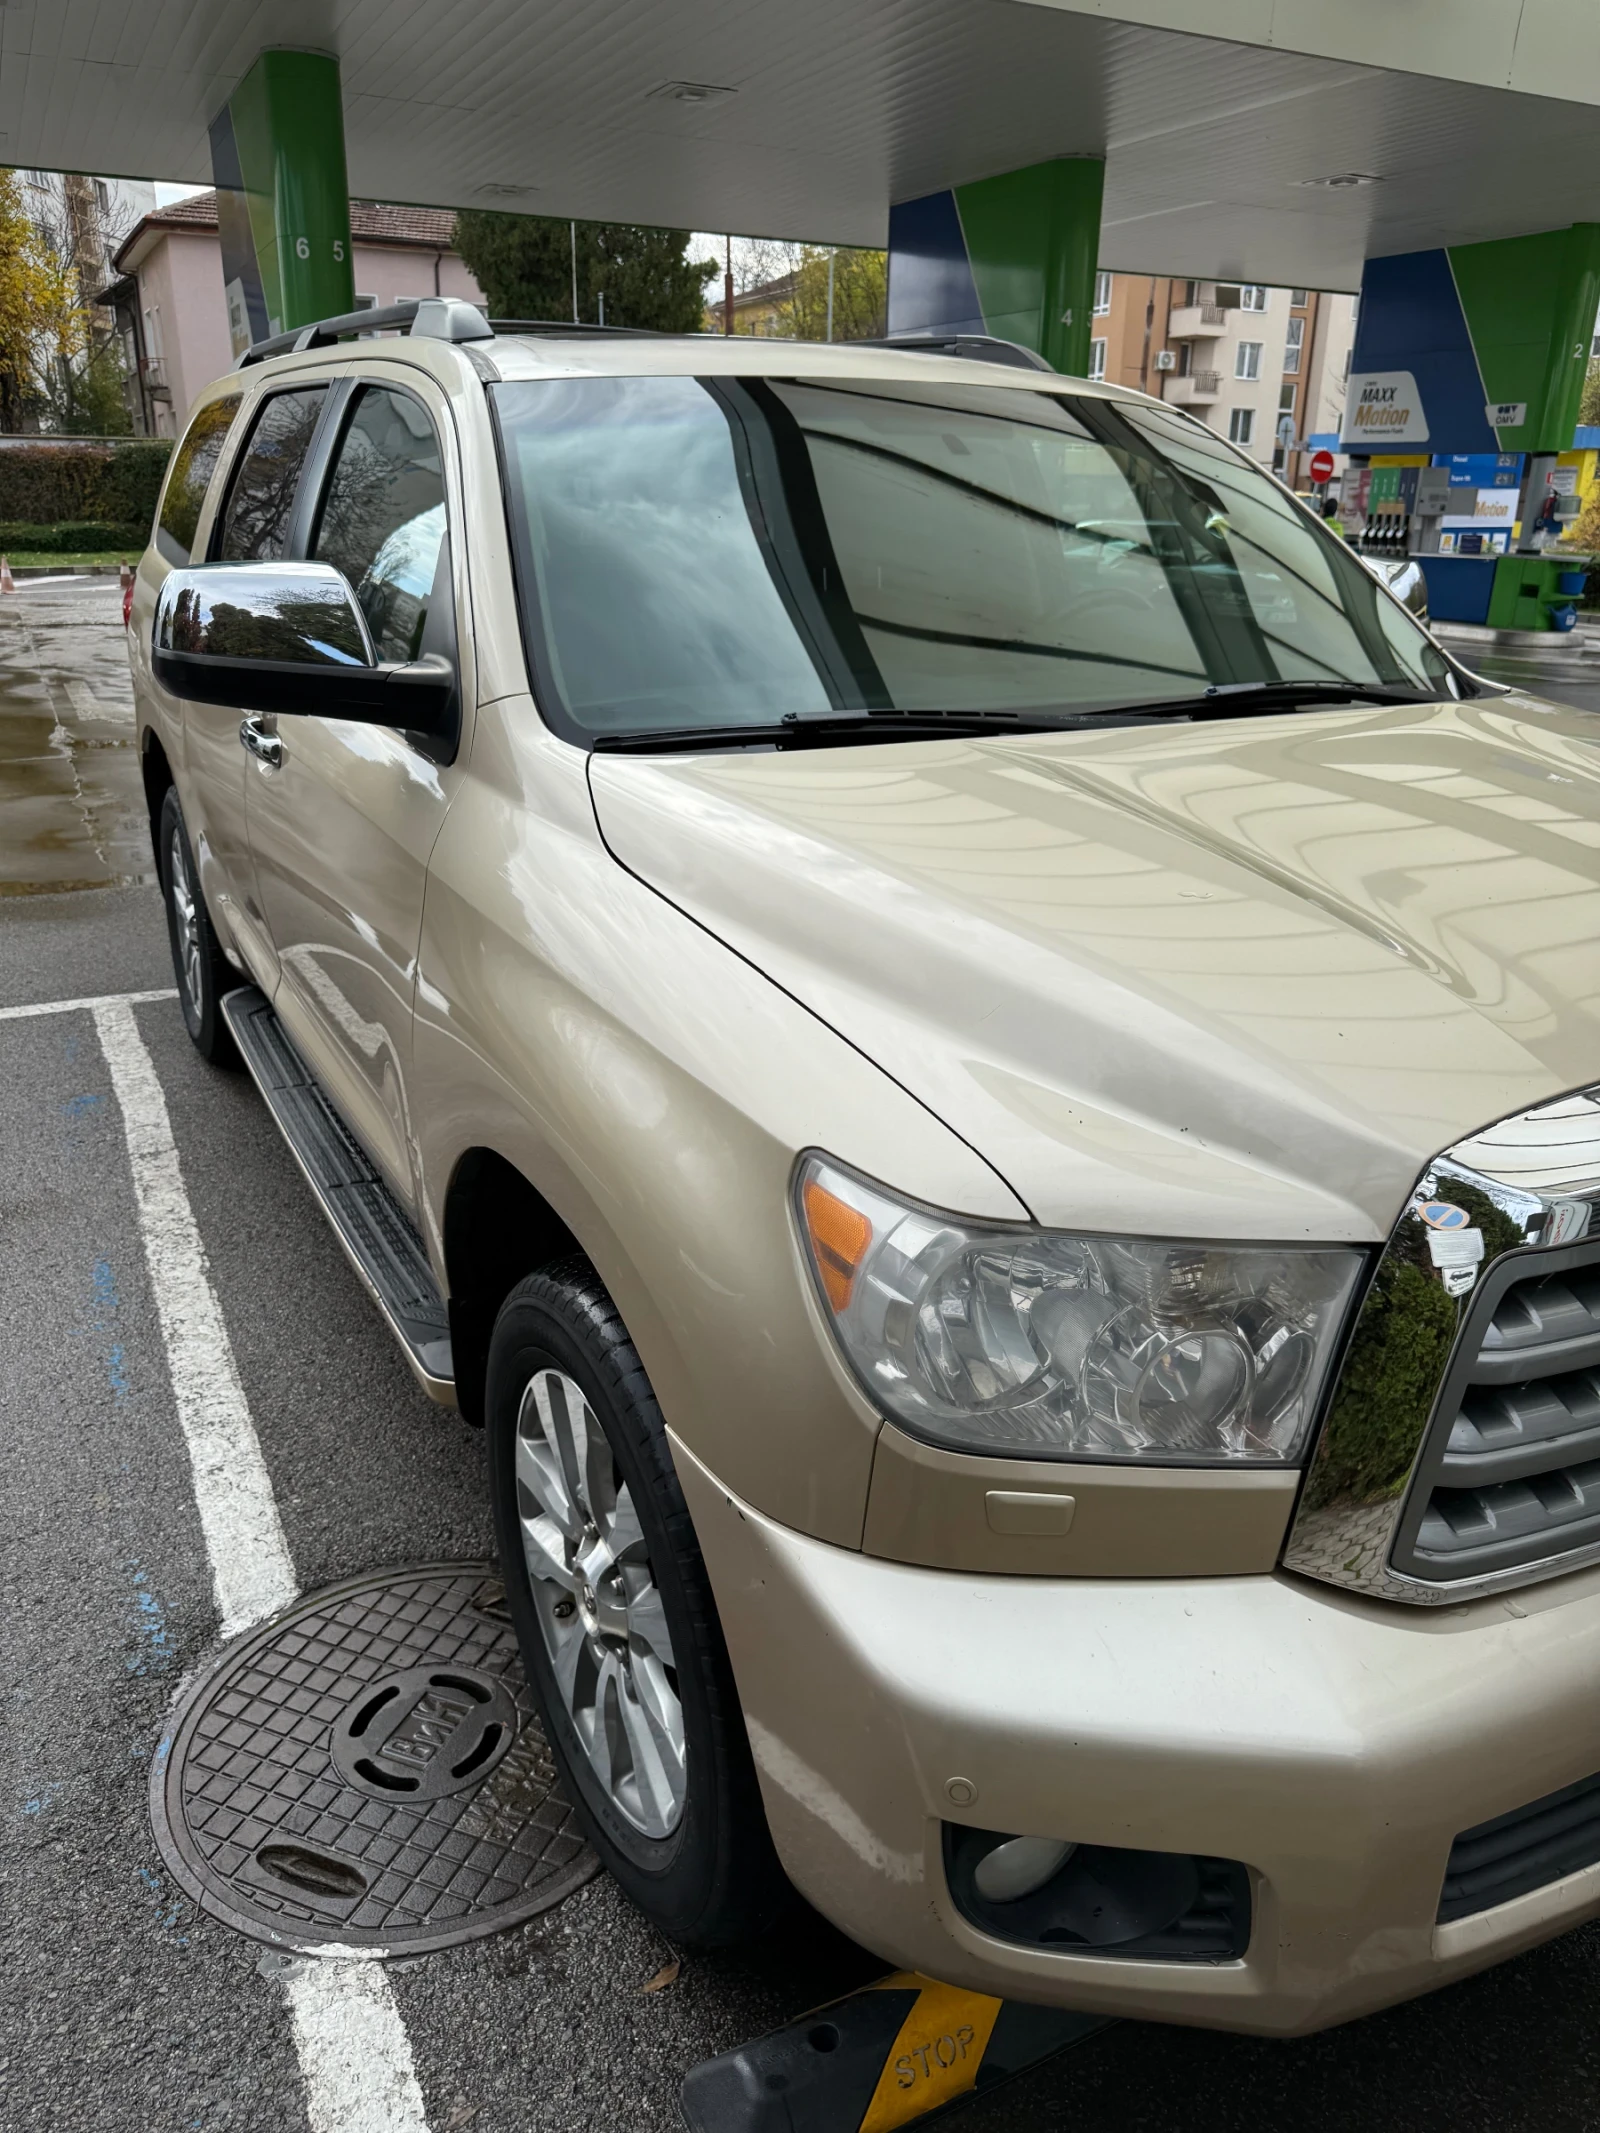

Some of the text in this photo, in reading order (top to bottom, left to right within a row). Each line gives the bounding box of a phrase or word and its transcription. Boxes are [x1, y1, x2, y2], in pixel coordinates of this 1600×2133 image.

[296, 237, 310, 259] 6
[333, 240, 345, 262] 5
[1061, 308, 1073, 327] 4
[1573, 343, 1584, 358] 2
[1360, 387, 1398, 403] MAXX
[1353, 404, 1410, 426] Motion
[1495, 416, 1516, 425] OMV
[1475, 501, 1509, 517] Motion
[895, 2025, 975, 2090] STOP
